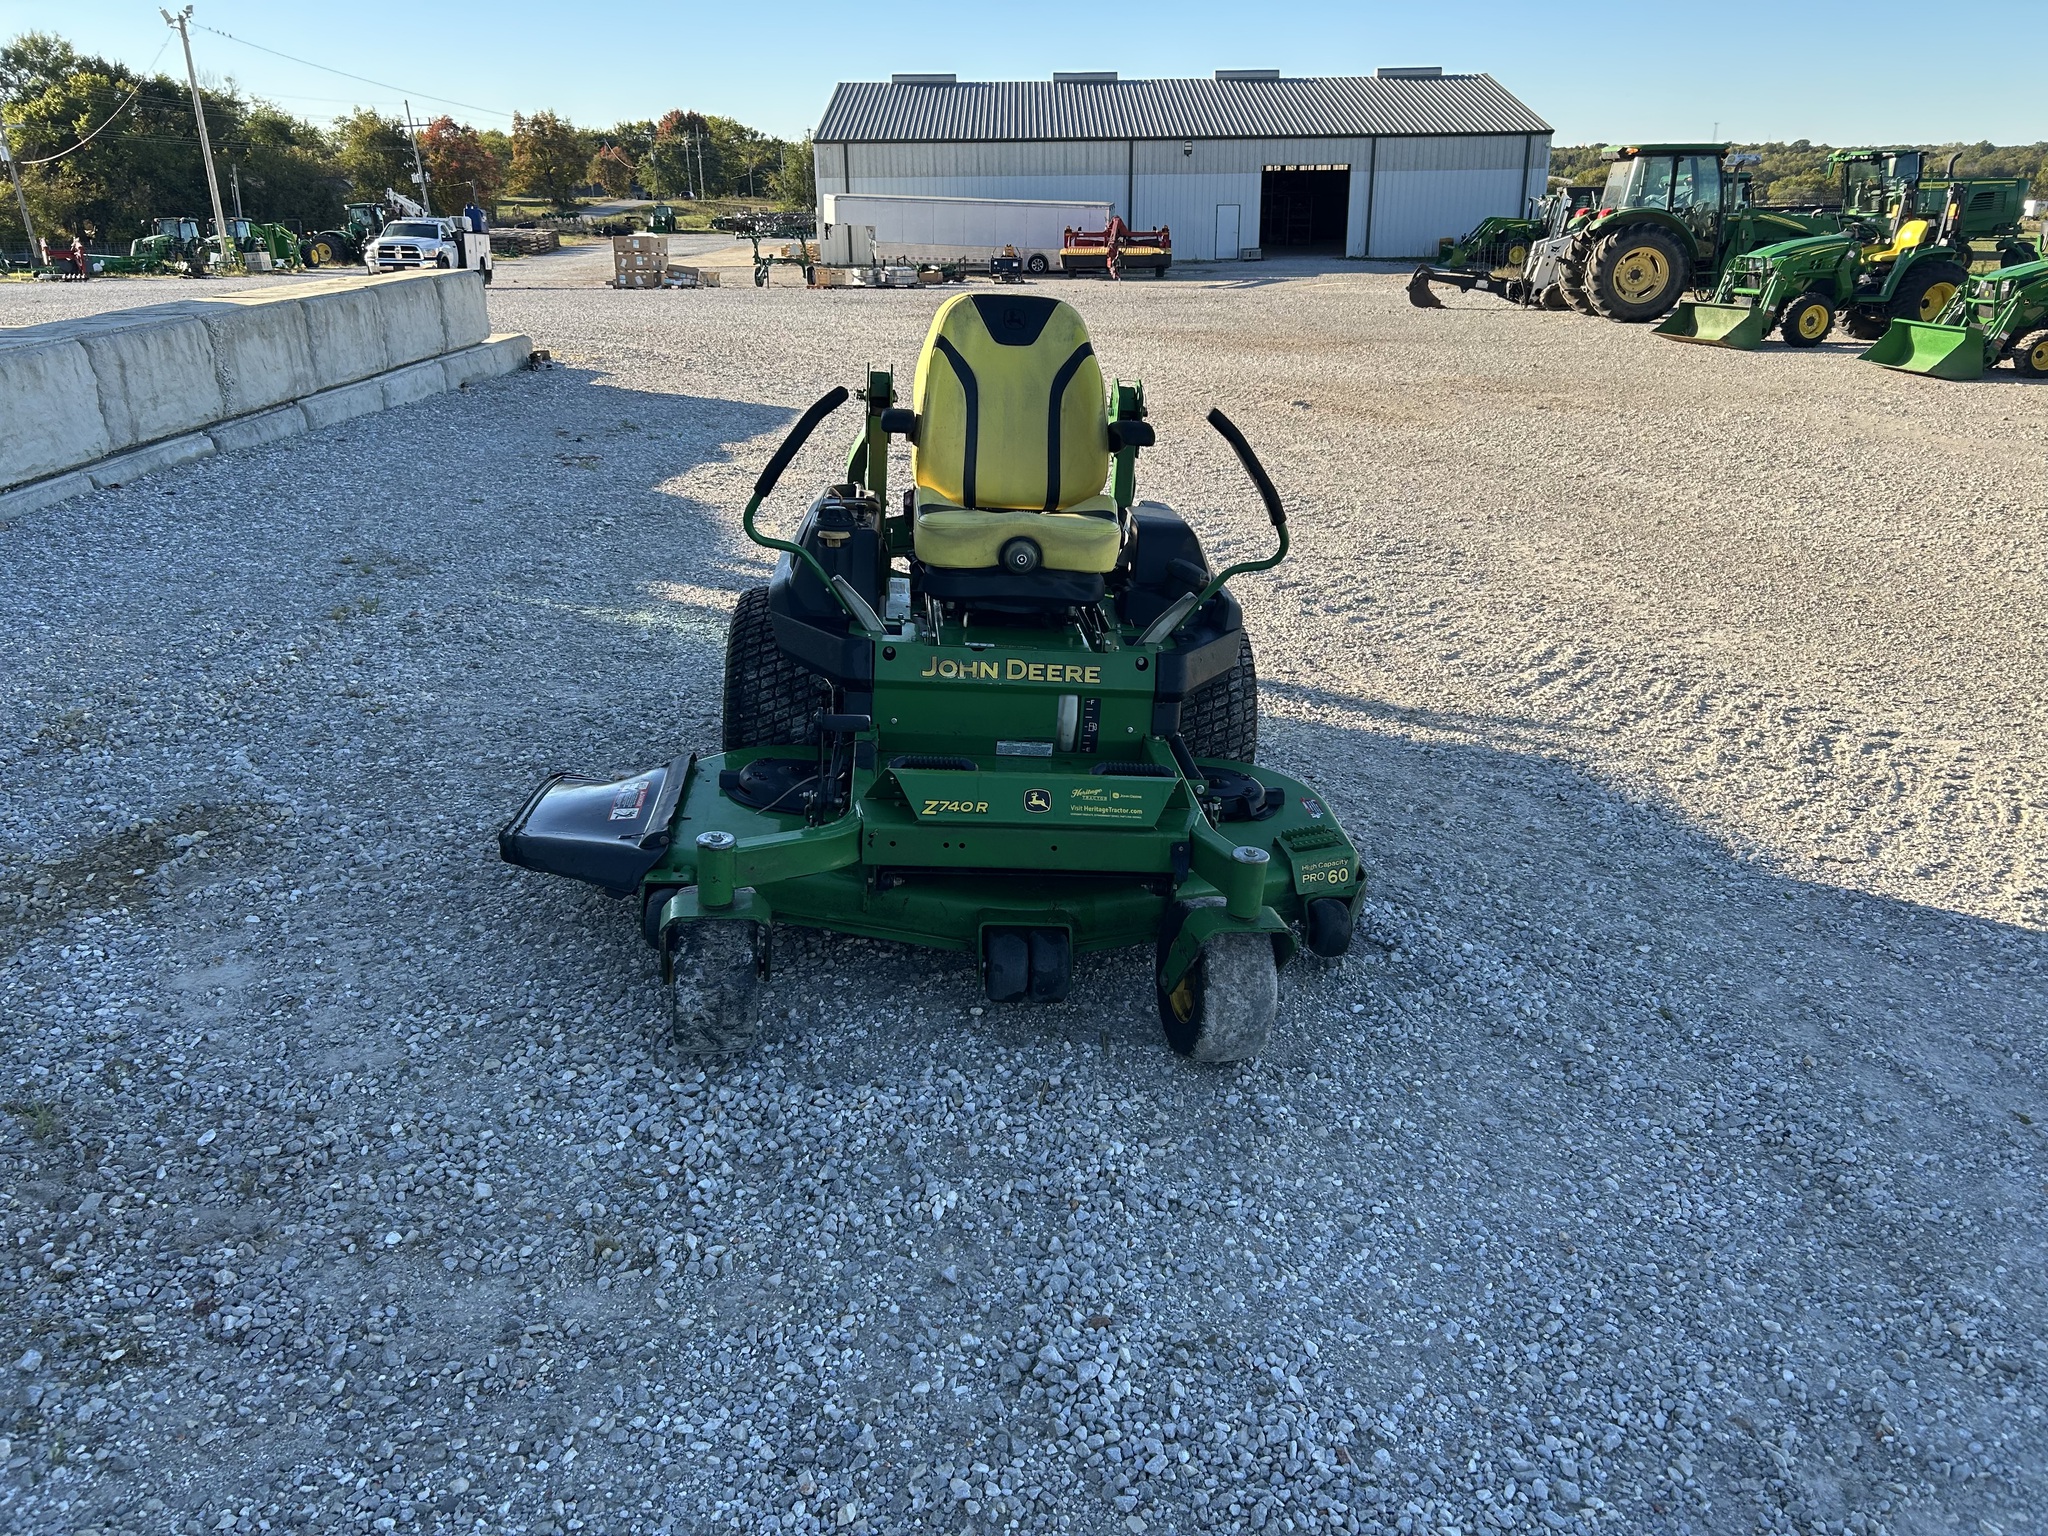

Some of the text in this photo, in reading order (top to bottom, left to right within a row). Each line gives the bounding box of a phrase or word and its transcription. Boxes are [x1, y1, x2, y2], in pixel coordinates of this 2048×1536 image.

[921, 656, 1101, 684] JOHN DEERE
[1084, 806, 1142, 814] HeritageTractor.com
[1318, 859, 1349, 869] Capacity
[1302, 867, 1349, 884] PRO 60
